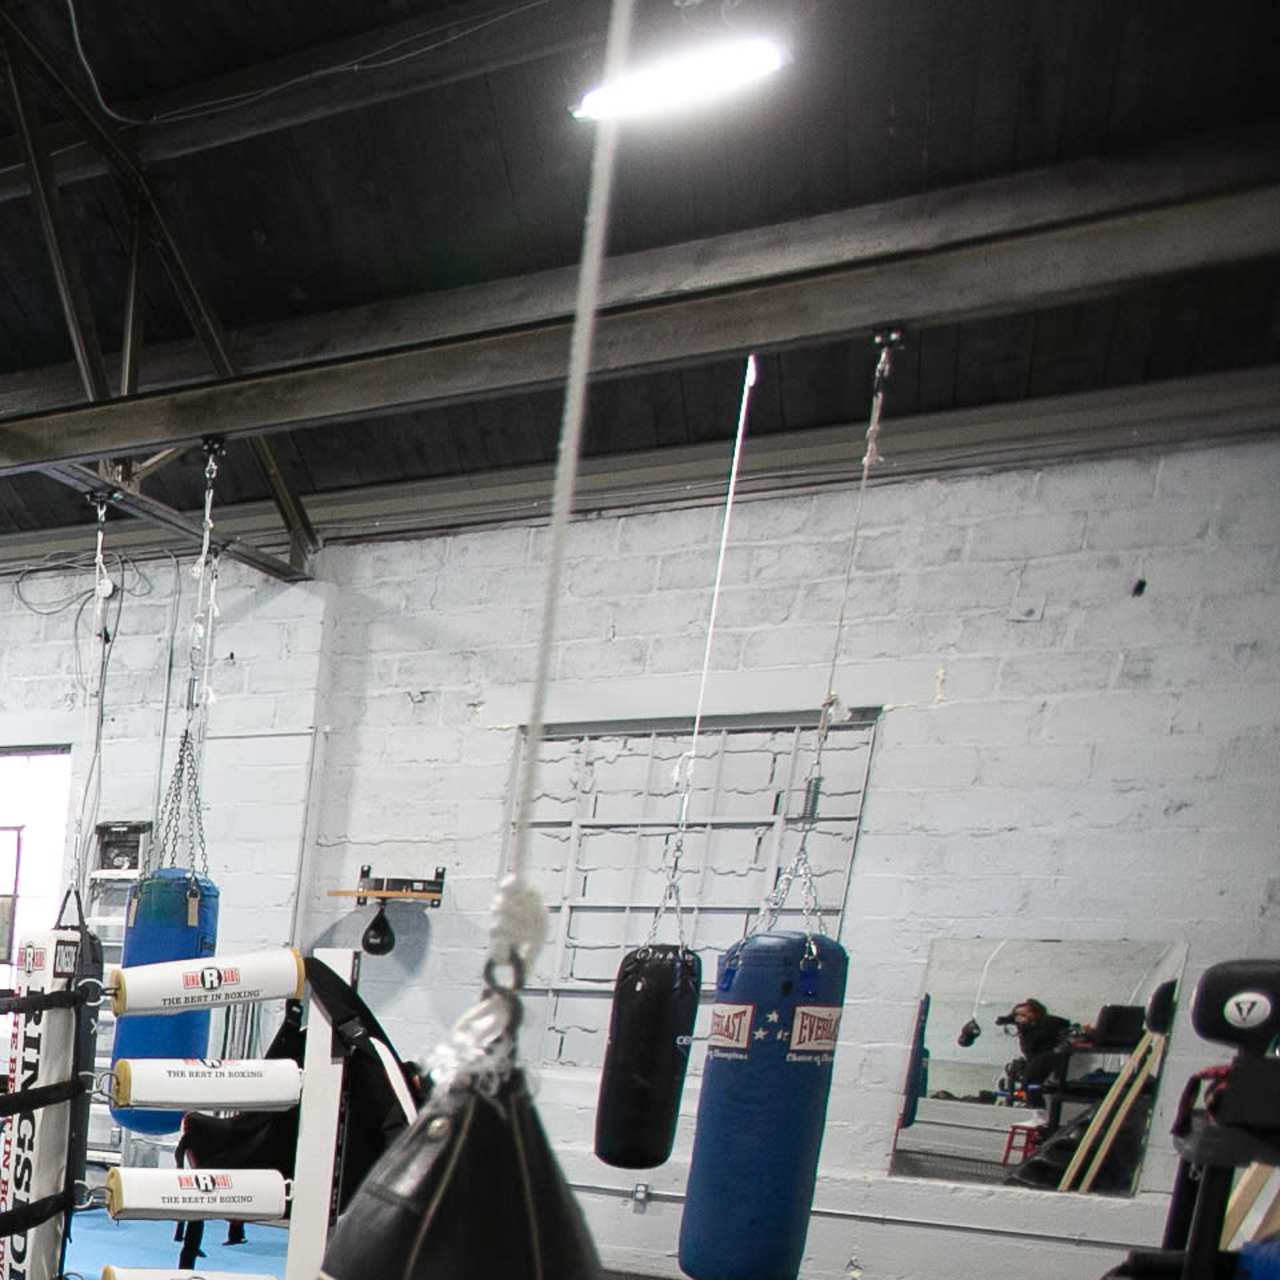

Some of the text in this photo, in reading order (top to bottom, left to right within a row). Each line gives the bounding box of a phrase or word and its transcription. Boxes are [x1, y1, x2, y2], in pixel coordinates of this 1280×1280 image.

[204, 968, 220, 989] R
[161, 990, 260, 1007] THE BEST IN BOXING
[167, 1070, 263, 1079] THE BEST IN BOXING
[2, 1138, 14, 1171] IN
[199, 1174, 214, 1191] R
[161, 1195, 253, 1204] THE BEST IN BOXING
